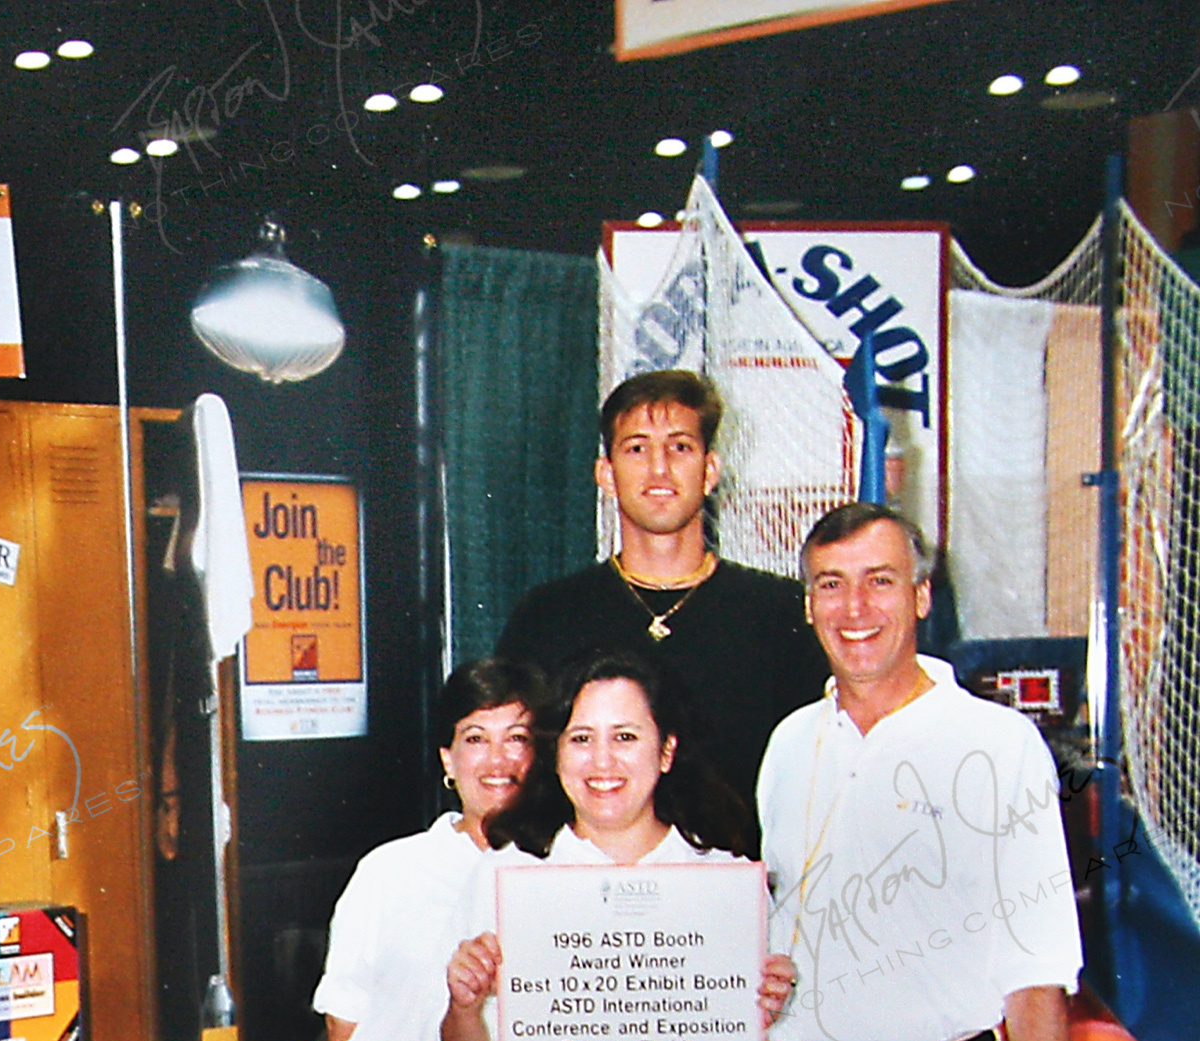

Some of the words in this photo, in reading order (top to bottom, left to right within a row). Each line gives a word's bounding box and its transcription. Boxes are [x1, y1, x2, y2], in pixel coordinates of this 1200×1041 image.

[254, 492, 318, 539] Join
[316, 538, 347, 566] the
[264, 564, 340, 611] Club!
[553, 933, 593, 948] 1996
[600, 932, 646, 948] ASTD
[654, 932, 704, 946] Booth
[570, 955, 621, 969] Award
[628, 955, 686, 969] Winner
[511, 977, 551, 993] Best
[560, 976, 578, 992] 10
[582, 980, 591, 991] x
[595, 976, 618, 992] 20
[626, 975, 686, 991] Exhibit
[694, 974, 747, 989] Booth
[550, 998, 595, 1013] ASTD
[603, 997, 709, 1012] International
[512, 1020, 610, 1036] Conference
[618, 1020, 649, 1034] and
[657, 1018, 746, 1037] Exposition
